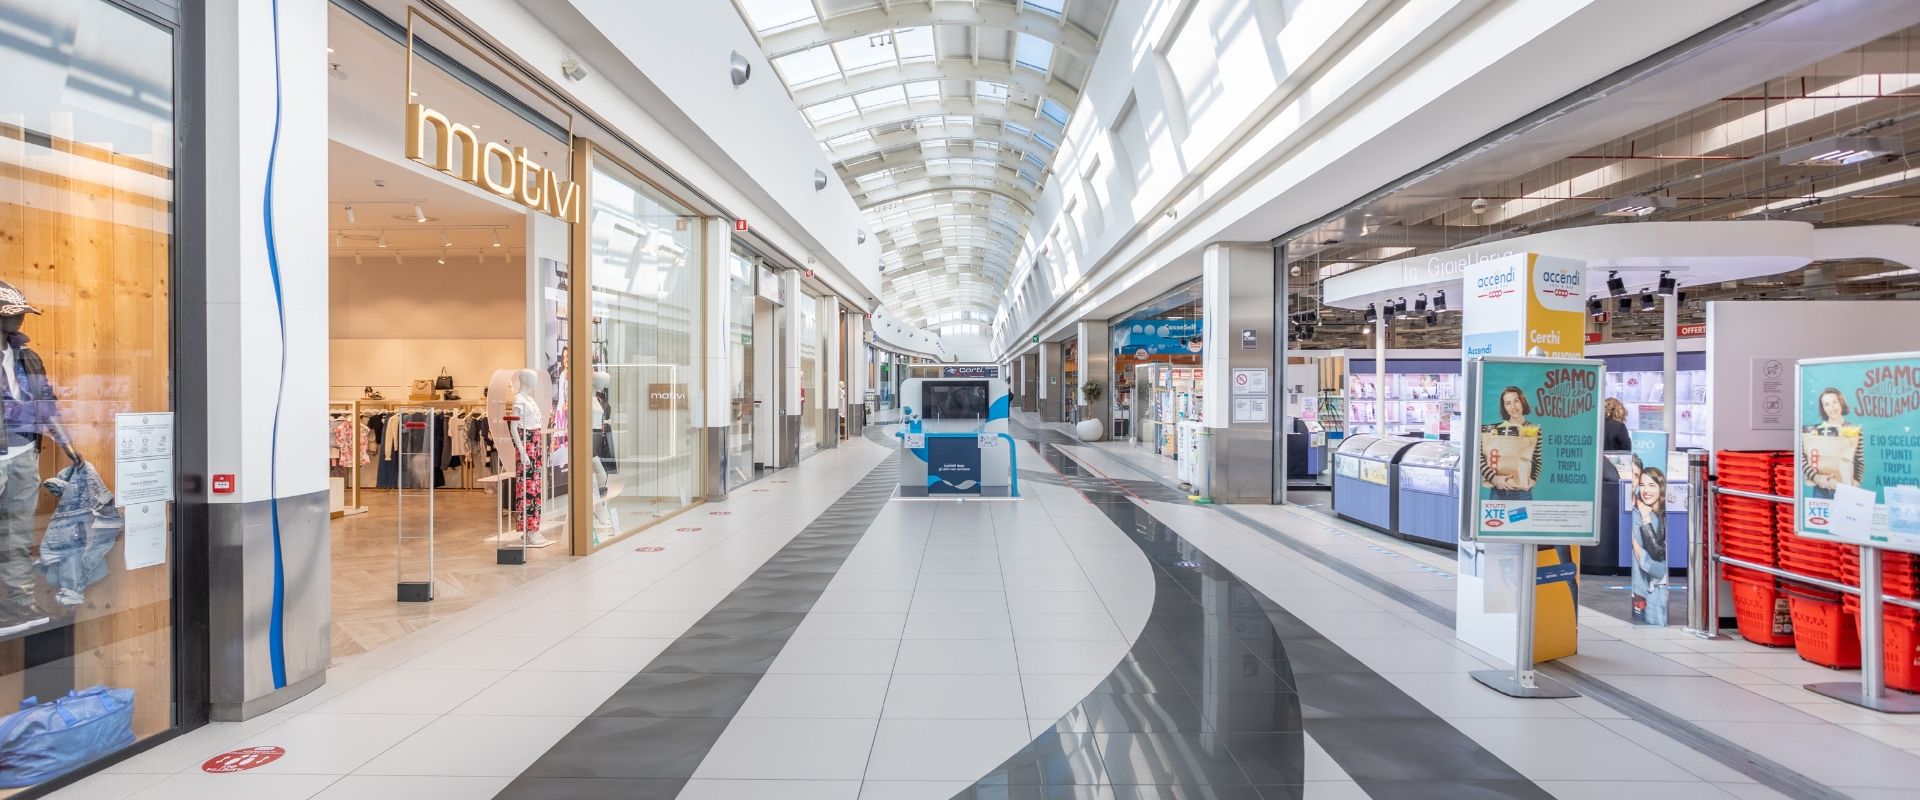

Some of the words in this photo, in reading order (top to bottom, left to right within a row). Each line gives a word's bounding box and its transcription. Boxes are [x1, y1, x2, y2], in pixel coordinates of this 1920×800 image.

[405, 103, 580, 224] motivi
[1477, 266, 1515, 288] accendi
[1543, 269, 1580, 286] accendi
[1530, 329, 1560, 345] Cerchi
[1467, 344, 1492, 355] Accendi
[1544, 368, 1596, 391] SIAMO
[651, 392, 685, 400] motivi
[1535, 388, 1595, 418] SCEGLIAMO.
[1548, 435, 1553, 445] E
[1554, 435, 1562, 445] IO
[1564, 435, 1592, 446] SCELGO
[1870, 435, 1875, 446] E
[1877, 435, 1885, 446] IO
[1560, 448, 1583, 458] PUNTI
[1885, 449, 1912, 460] PUNTI
[1557, 461, 1581, 471] TRIPLI
[1883, 462, 1911, 474] TRIPLI
[1550, 474, 1556, 484] A
[1557, 474, 1588, 485] MAGGIO.
[1875, 475, 1881, 486] A
[1484, 509, 1505, 519] XTE
[1808, 507, 1829, 518] XTE
